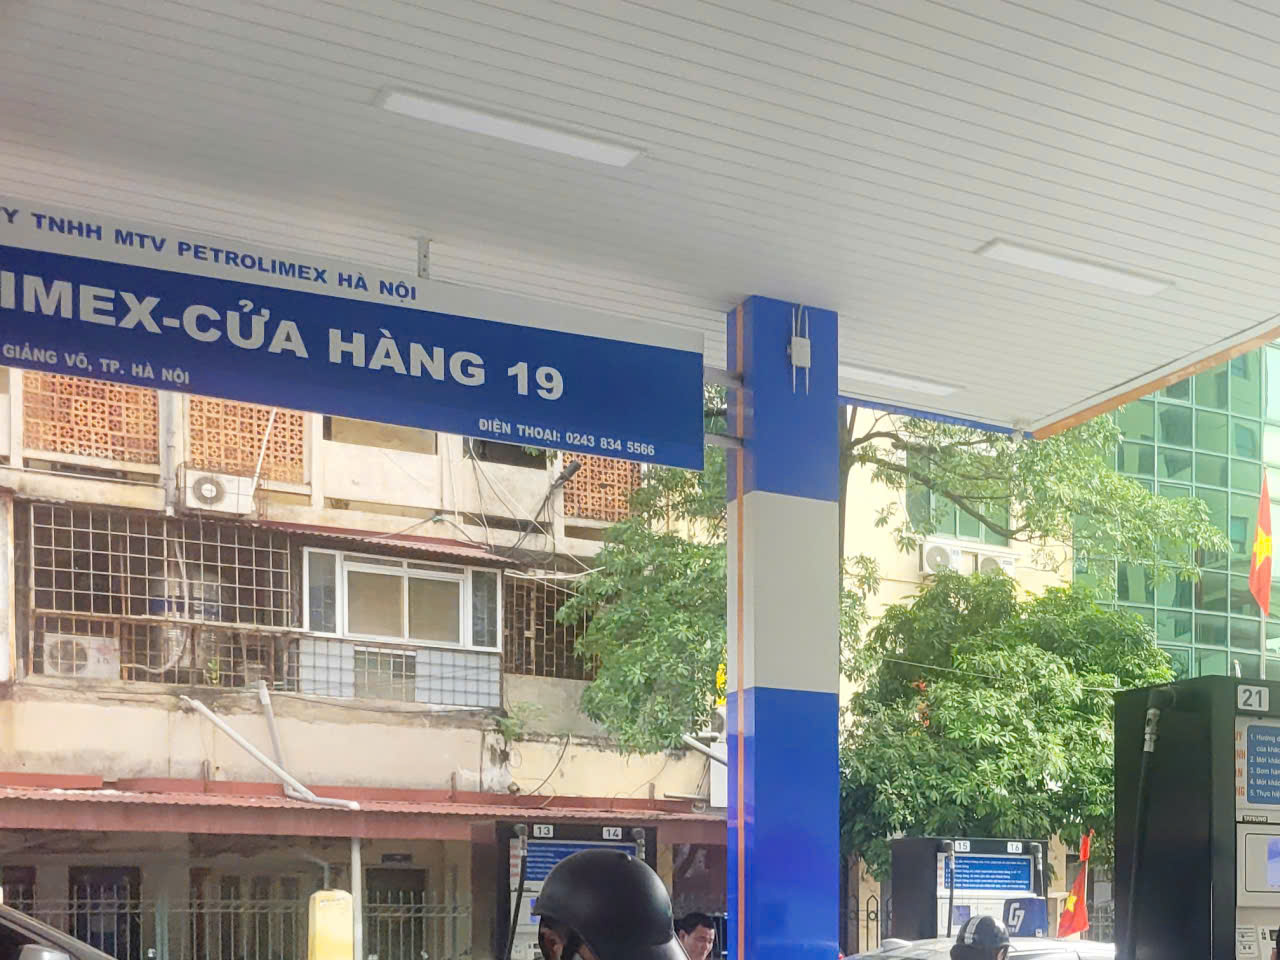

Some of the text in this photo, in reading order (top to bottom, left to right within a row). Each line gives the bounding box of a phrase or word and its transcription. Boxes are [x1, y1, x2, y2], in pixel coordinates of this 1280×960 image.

[31, 212, 103, 241] TNHH
[114, 228, 167, 253] MTV
[177, 241, 328, 284] PETROLIMEX
[338, 272, 369, 291] HÀ
[379, 279, 417, 303] NỘI
[2, 342, 190, 387] GIẢNG VÕ, TP. HÀ NỘI
[329, 329, 486, 386] HÀNG
[506, 362, 565, 401] 19
[478, 418, 655, 456] ĐIỆN THOẠI: 0243 834 5566
[1242, 688, 1263, 708] 21
[536, 826, 551, 836] 13
[606, 828, 620, 838] 14
[957, 841, 968, 850] 15
[1009, 843, 1020, 852] 16
